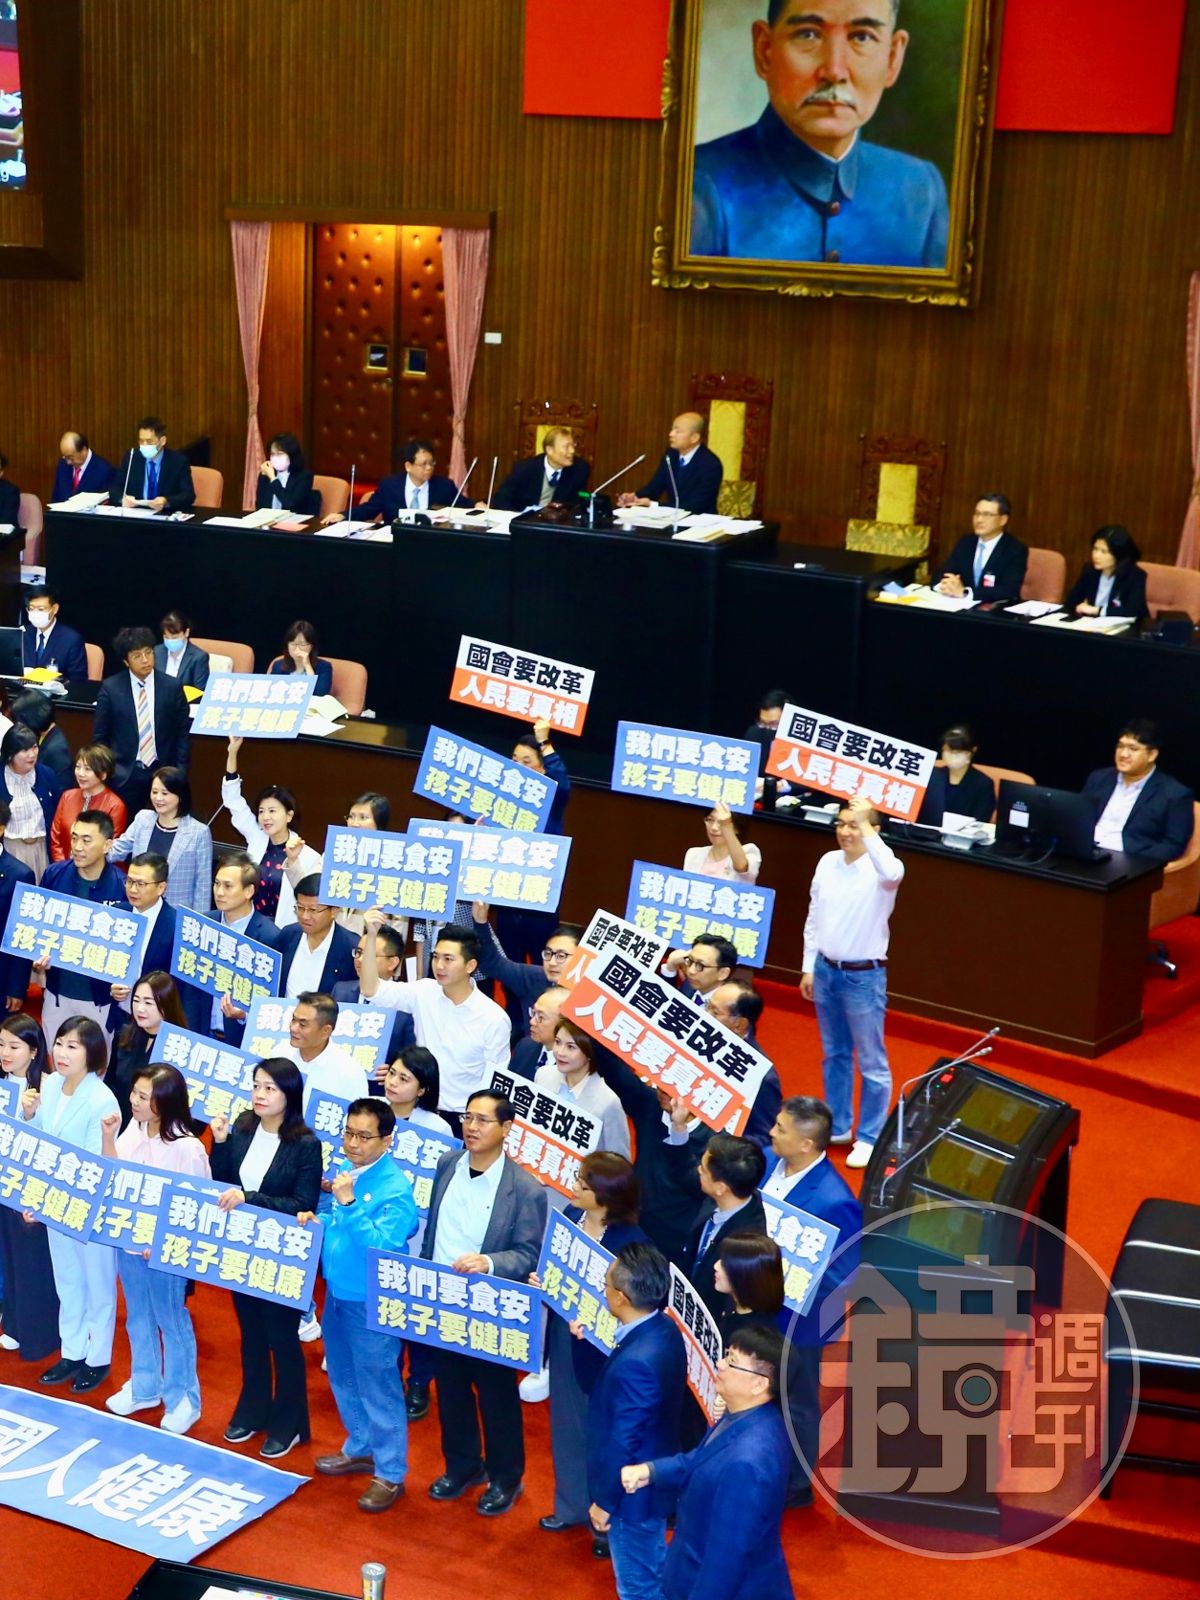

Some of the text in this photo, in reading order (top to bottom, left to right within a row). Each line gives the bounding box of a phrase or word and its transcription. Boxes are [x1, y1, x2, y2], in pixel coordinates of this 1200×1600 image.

[210, 677, 309, 705] 我們要食安
[465, 642, 585, 697] 國會要改革
[200, 706, 298, 733] 孩子要健康
[459, 674, 579, 730] 人民要真相
[432, 736, 549, 809] 我們要食安
[625, 729, 753, 775] 我們要食安
[788, 712, 926, 778] 國會要改革
[423, 766, 540, 834] 孩子要健康
[621, 761, 748, 806] 孩子要健康
[776, 746, 918, 816] 人民要真相
[333, 833, 453, 877] 我們要食安
[19, 891, 140, 947] 我們要食安
[328, 870, 449, 914] 孩子要健康
[639, 870, 766, 923] 我們要食安
[10, 922, 132, 980] 孩子要健康
[182, 915, 275, 984] 我們要食安
[599, 953, 757, 1083] 國會要改革
[575, 995, 733, 1121] 人民要真相
[168, 1194, 315, 1262] 我們要食安
[161, 1232, 306, 1301] 孩子要健康
[377, 1257, 532, 1325] 我們要食安
[377, 1295, 531, 1365] 孩子要健康
